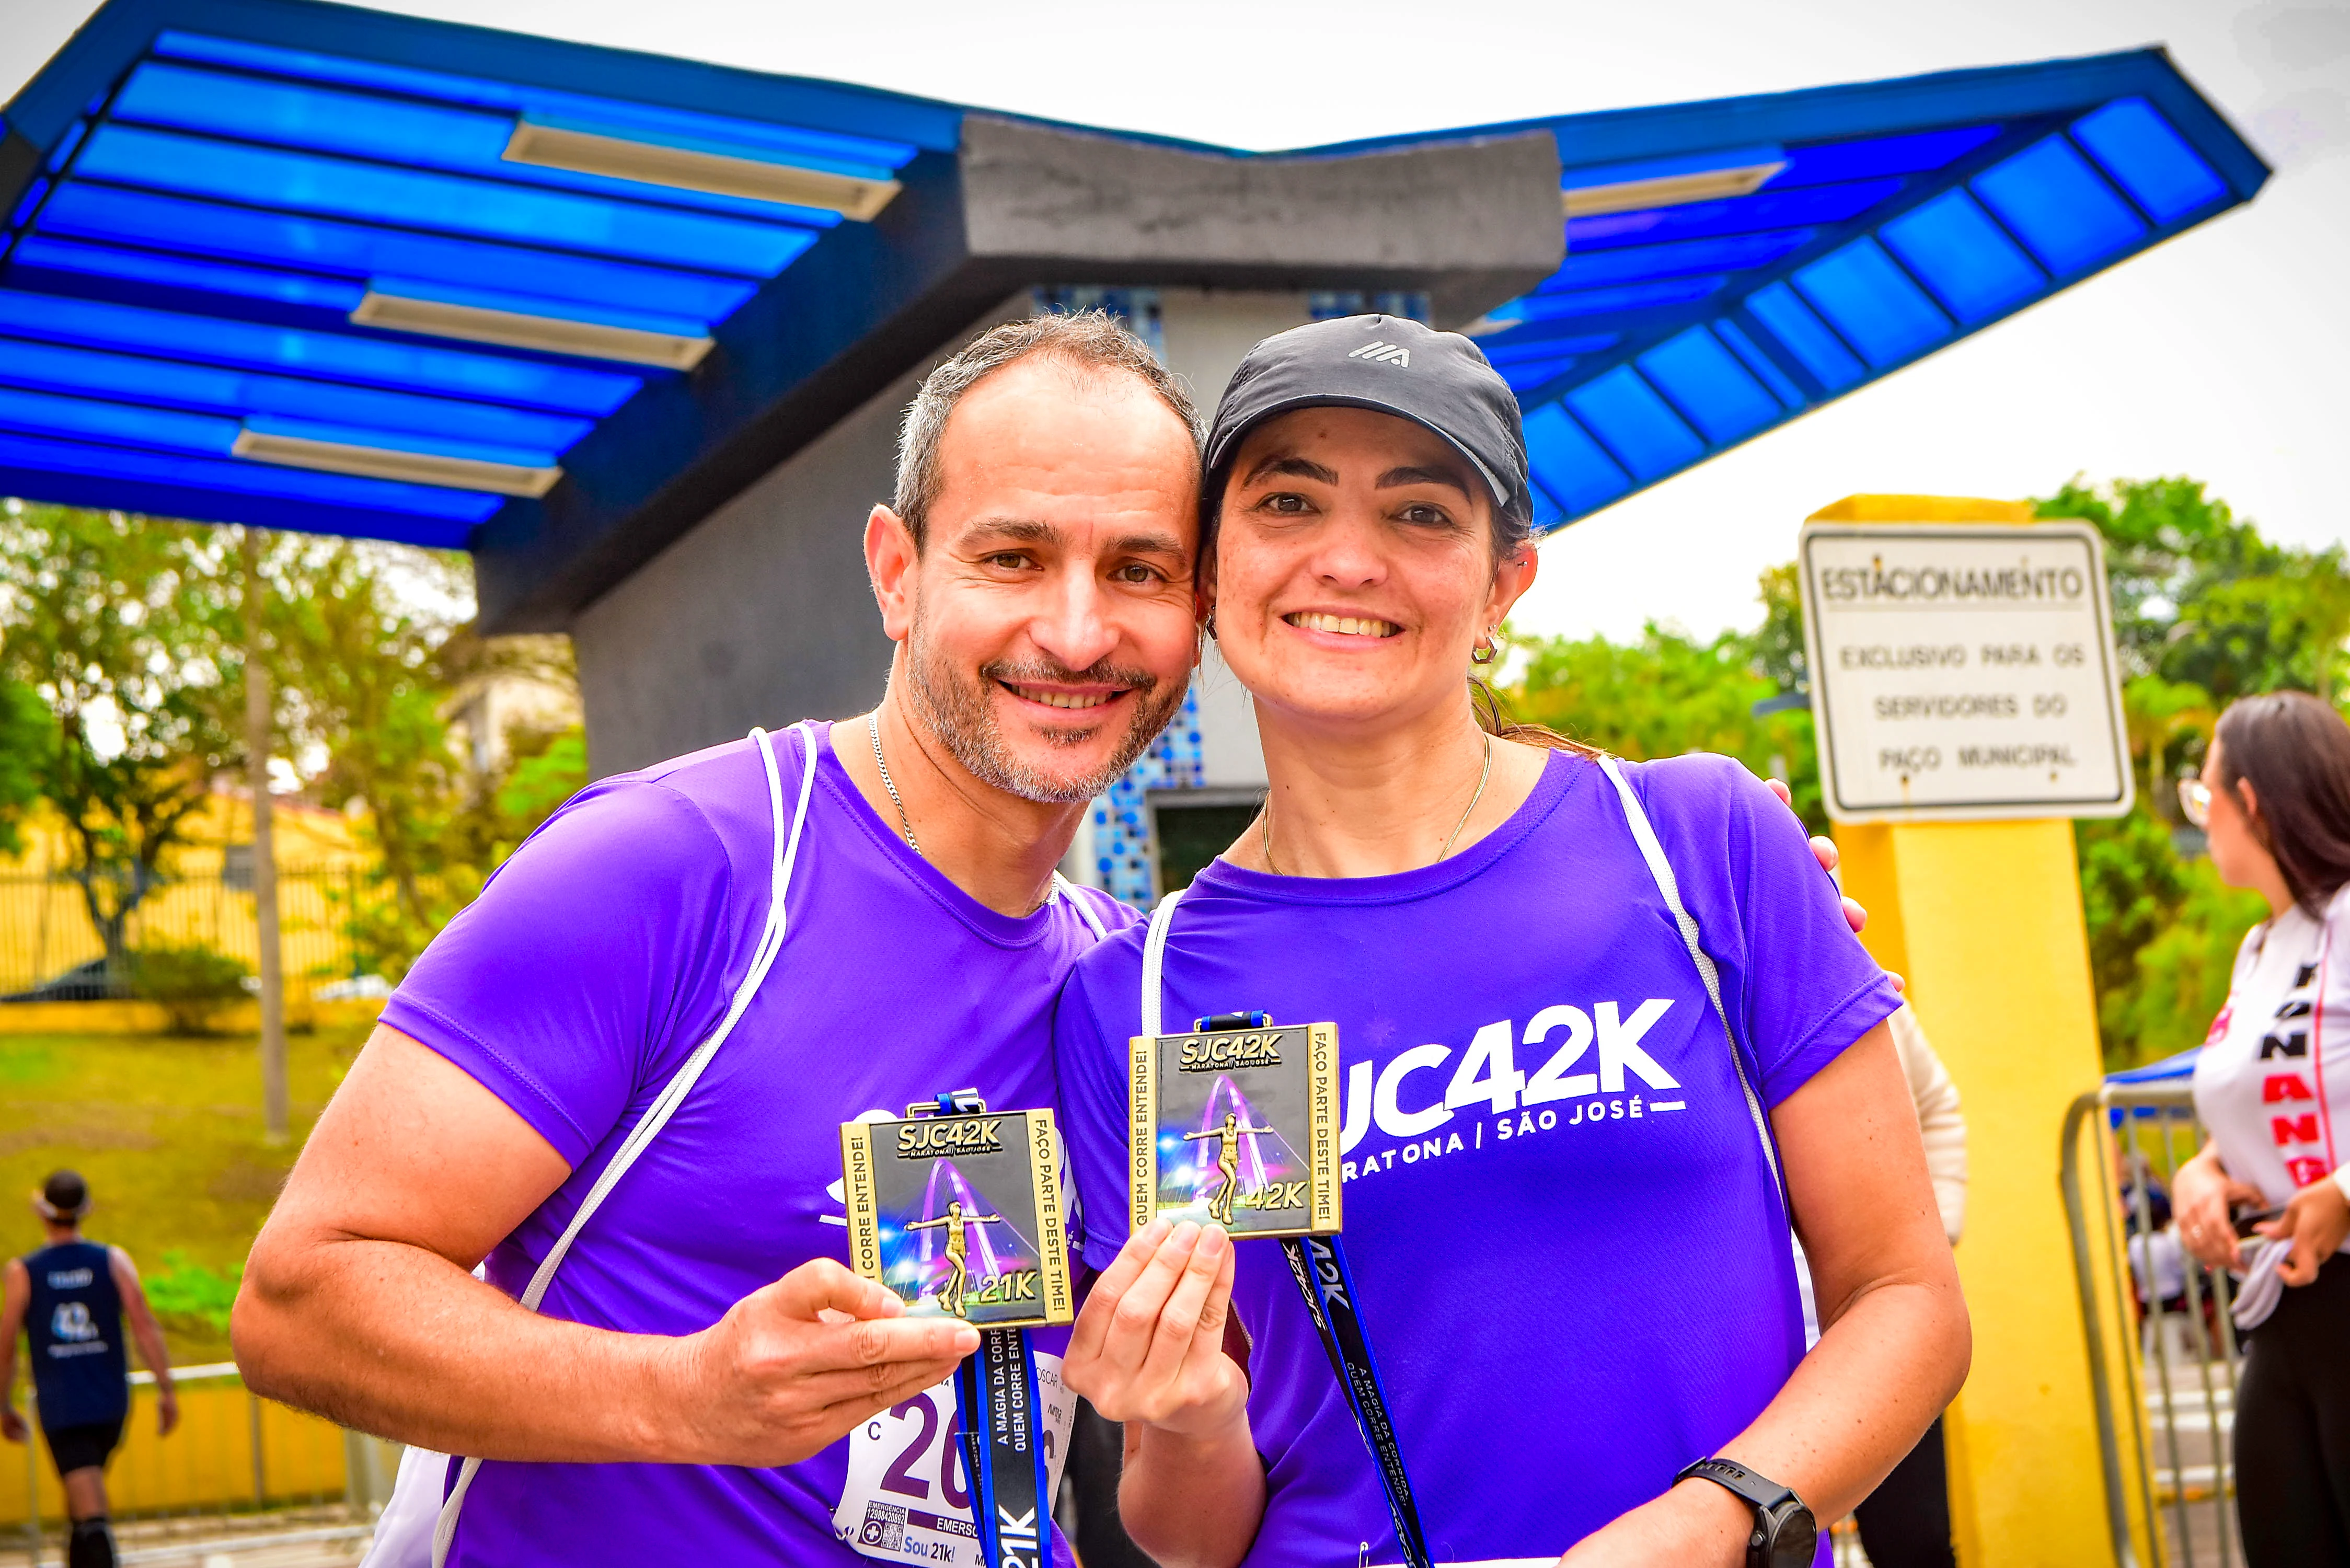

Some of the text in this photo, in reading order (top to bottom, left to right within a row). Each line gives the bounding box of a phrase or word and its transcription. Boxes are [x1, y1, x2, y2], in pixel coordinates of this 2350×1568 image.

[1822, 567, 2083, 602] ESTACIONAMENTO
[1840, 643, 2084, 670] EXCLUSIVO PARA OS
[1874, 695, 2067, 721] SERVIDORES DO
[1880, 743, 2075, 773] PAÇO MUNICIPAL
[1180, 1033, 1283, 1064] SJC42K
[1191, 1061, 1228, 1070] MARATONA
[1313, 1032, 1327, 1071] FAÇO
[1340, 999, 1681, 1157] JC42K
[1316, 1077, 1328, 1124] PARTE
[898, 1119, 1001, 1150] SJC42K
[1136, 1051, 1148, 1226] QUEM CORRE ENTENDE!
[1317, 1128, 1329, 1175] DESTE
[1342, 1132, 1464, 1183] RATONA
[1497, 1110, 1557, 1140] SÃO
[1569, 1094, 1643, 1126] JOSÉ
[851, 1137, 869, 1213] ENTENDE!
[1245, 1181, 1306, 1210] 42K
[1035, 1119, 1065, 1311] FAÇO PARTE DESTE TIME!
[858, 1217, 874, 1270] CORRE
[980, 1271, 1038, 1302] 21K
[993, 1366, 1005, 1386] DA
[1010, 1362, 1023, 1409] CORRE
[1036, 1366, 1058, 1389] OSCAR
[994, 1388, 1008, 1433] MAGIA
[1347, 1362, 1366, 1397] QUEM
[1362, 1400, 1384, 1442] CORRE
[1359, 1367, 1367, 1377] A
[1364, 1379, 1383, 1418] MAGIA
[1380, 1421, 1390, 1438] DA
[867, 1421, 882, 1441] C
[997, 1434, 1009, 1446] A
[1012, 1412, 1027, 1452] QUEM
[867, 1507, 905, 1525] 12988420892
[903, 1536, 928, 1558] Sou
[930, 1542, 956, 1563] 21k!
